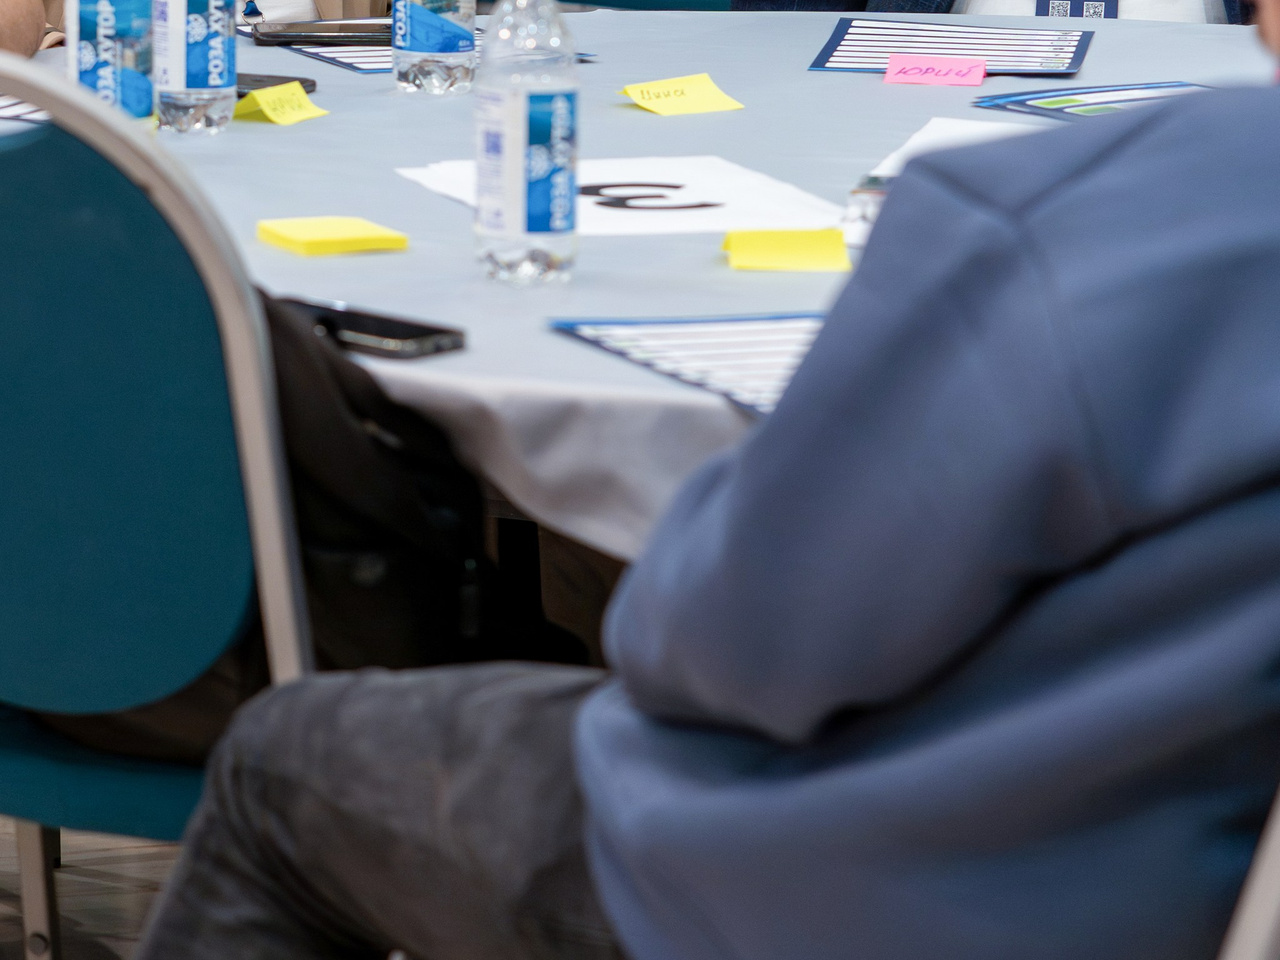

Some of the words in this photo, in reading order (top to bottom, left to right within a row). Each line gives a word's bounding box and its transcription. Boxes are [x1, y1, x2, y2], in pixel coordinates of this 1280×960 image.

[394, 0, 407, 47] РОЗА
[208, 35, 225, 86] РОЗА
[96, 64, 116, 106] ОЗА
